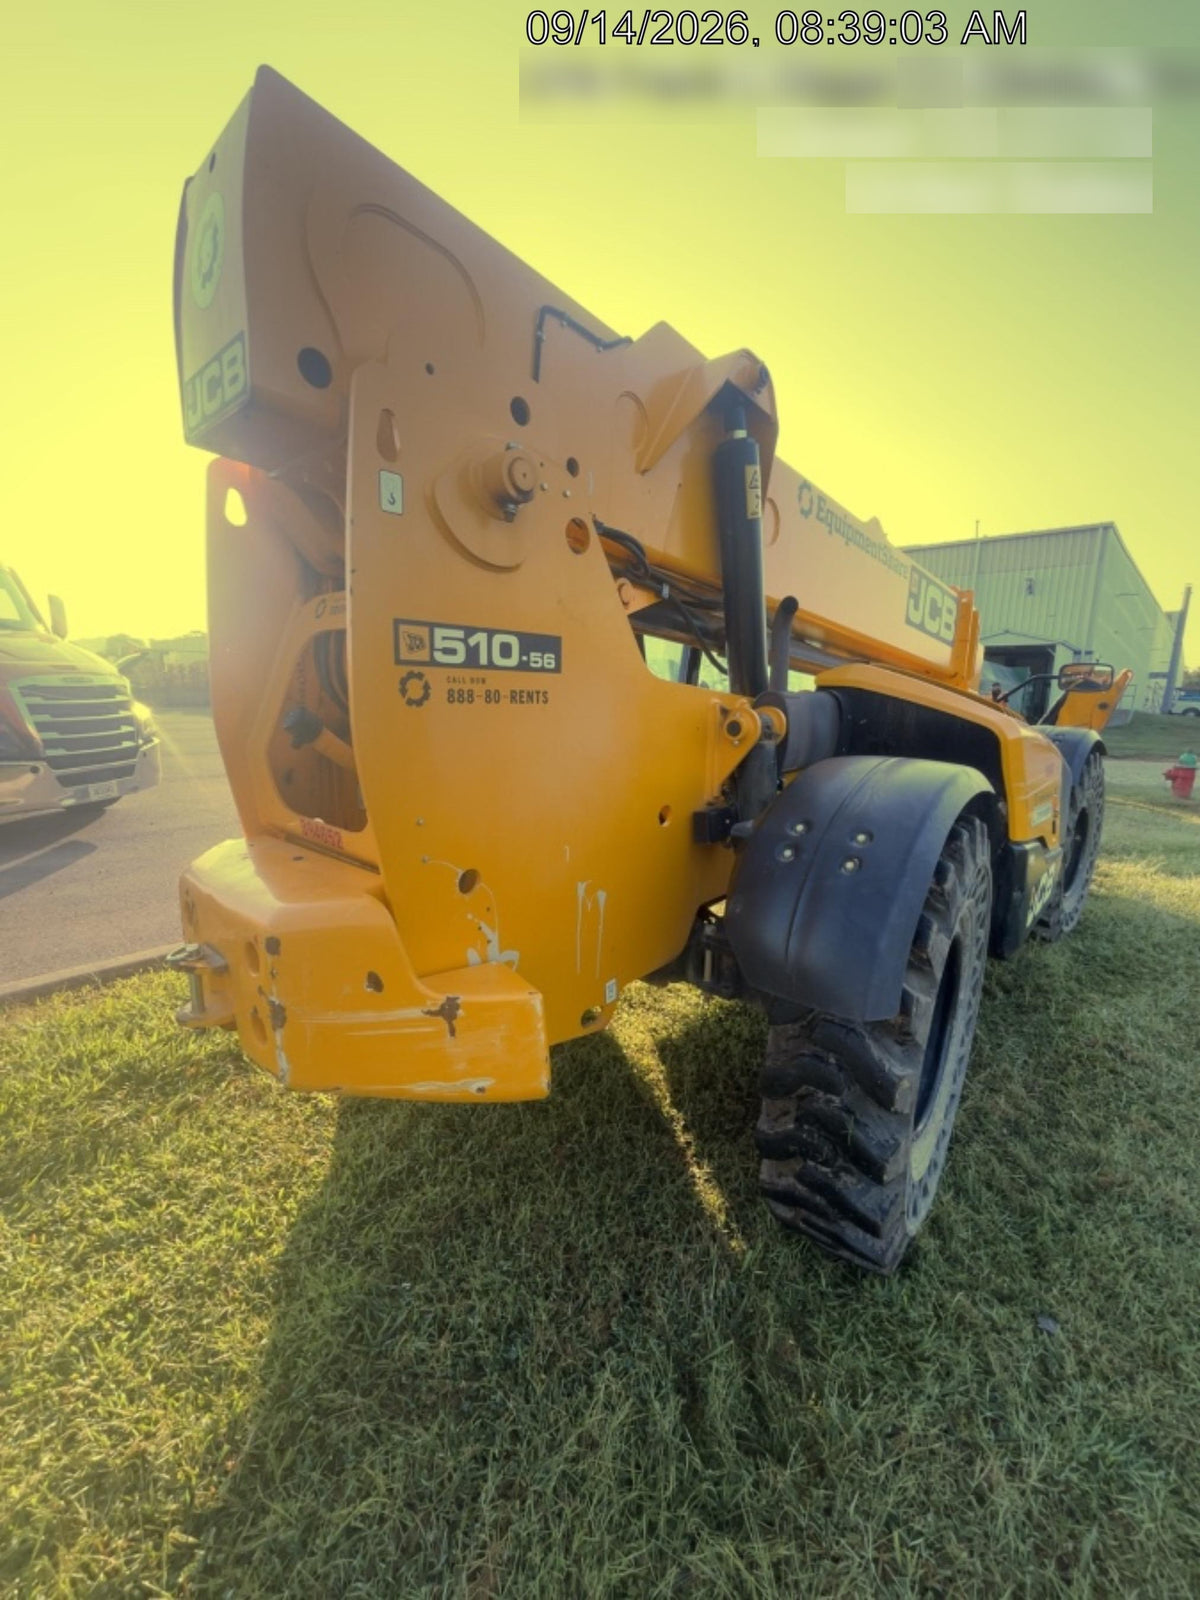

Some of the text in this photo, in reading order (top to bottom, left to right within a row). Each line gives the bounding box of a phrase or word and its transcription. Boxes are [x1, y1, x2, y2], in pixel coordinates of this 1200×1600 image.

[187, 341, 246, 428] JCB
[908, 578, 957, 641] JCB
[433, 627, 556, 669] 510-56
[446, 675, 467, 684] CALL
[447, 688, 549, 705] 888-80-RENTS
